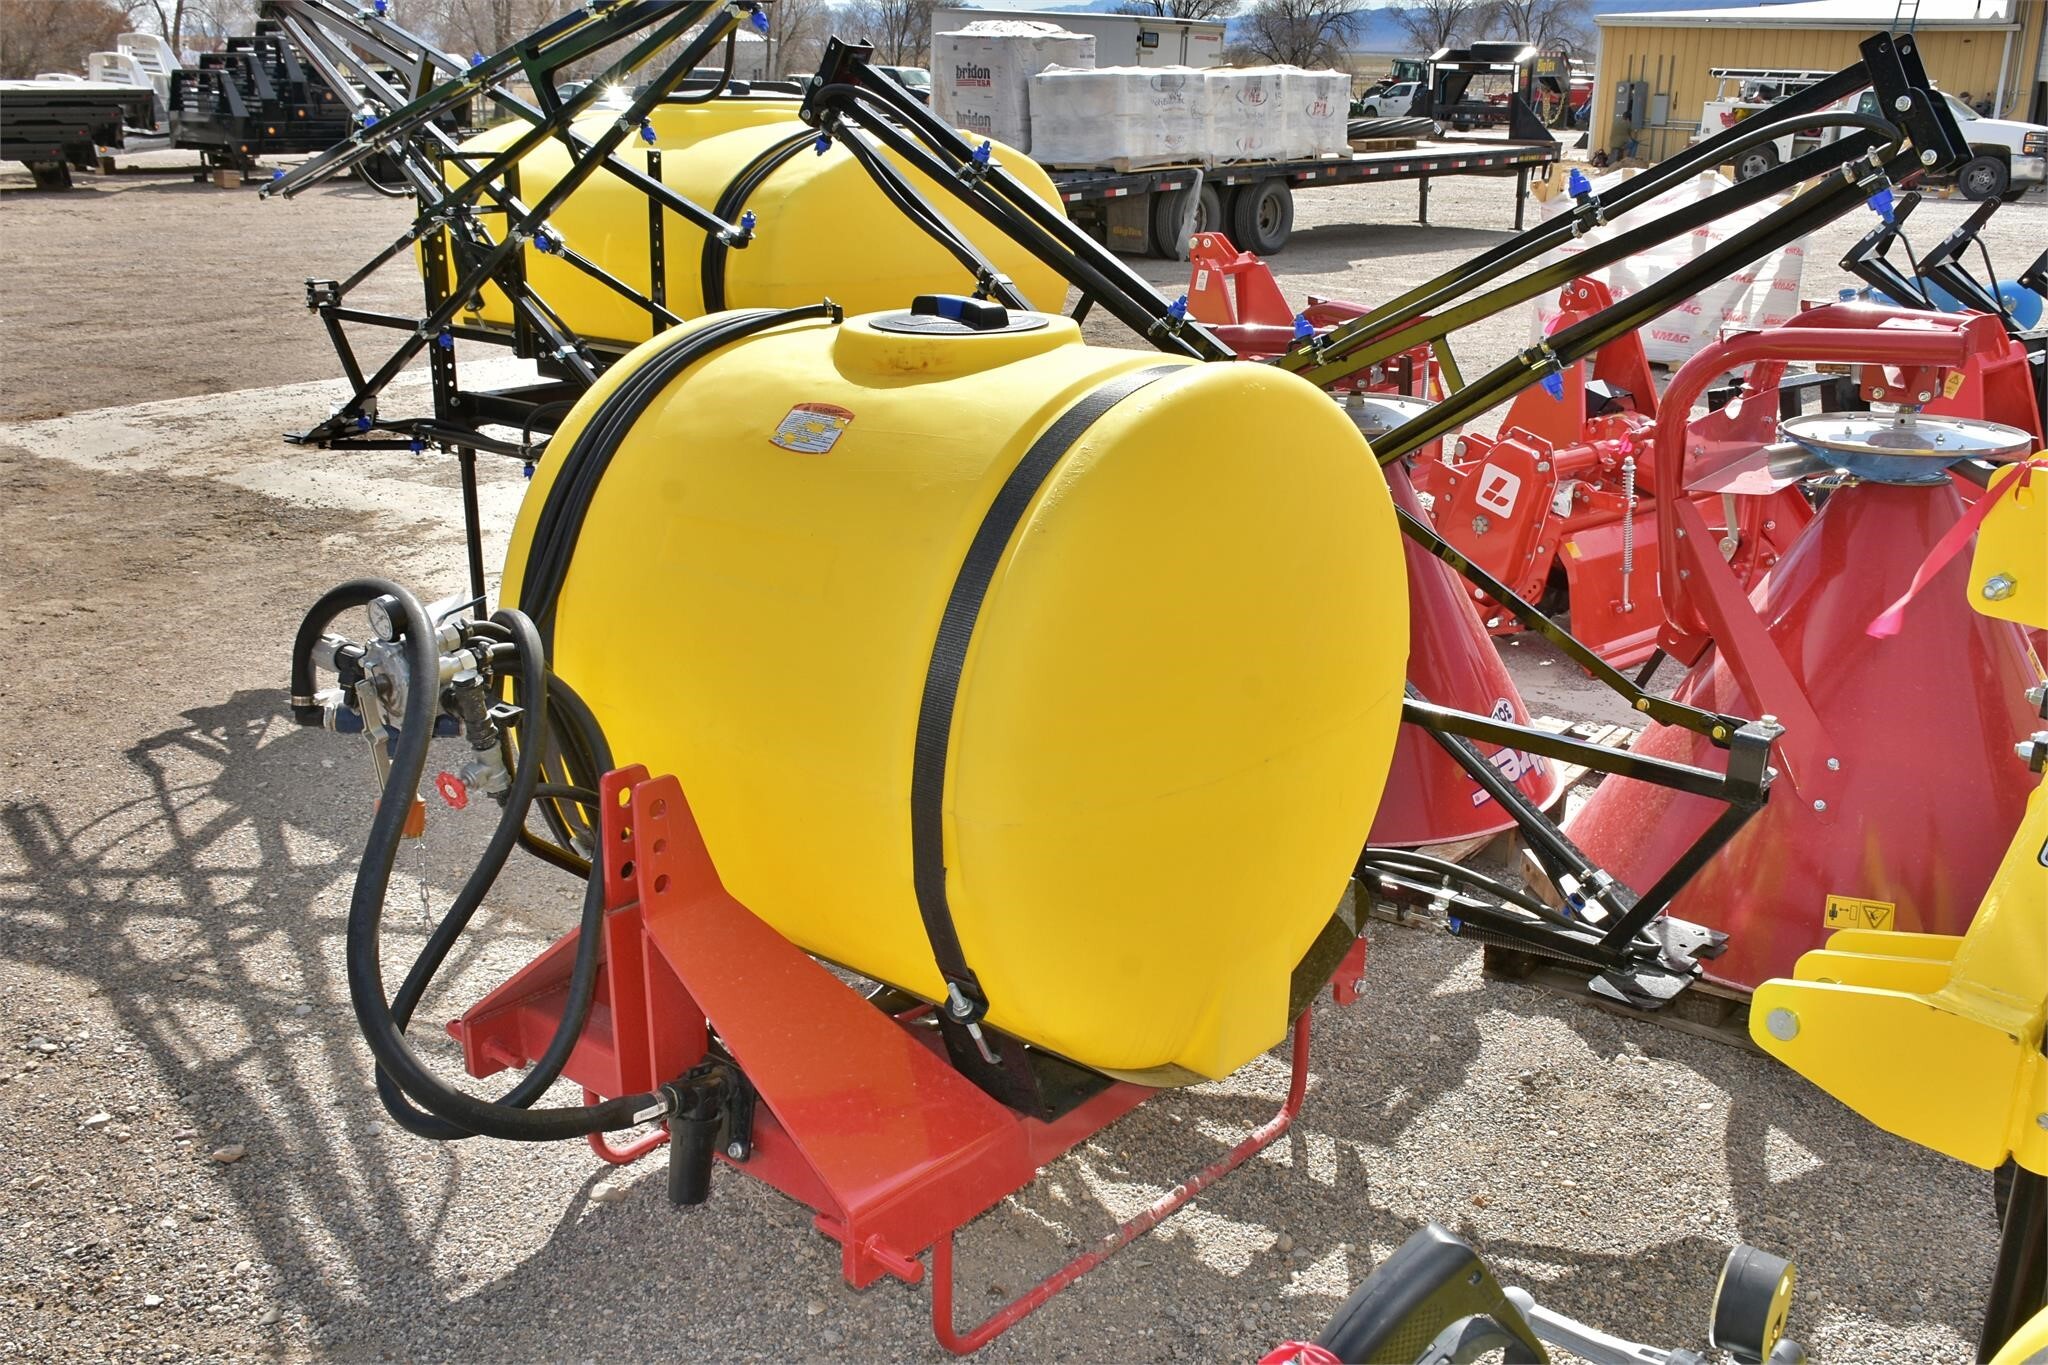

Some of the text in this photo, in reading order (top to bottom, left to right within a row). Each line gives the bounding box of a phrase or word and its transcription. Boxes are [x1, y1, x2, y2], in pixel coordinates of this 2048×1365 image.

[956, 62, 991, 79] bridon
[976, 79, 991, 87] USA
[956, 109, 991, 127] bridon
[1651, 329, 1691, 344] VMAC
